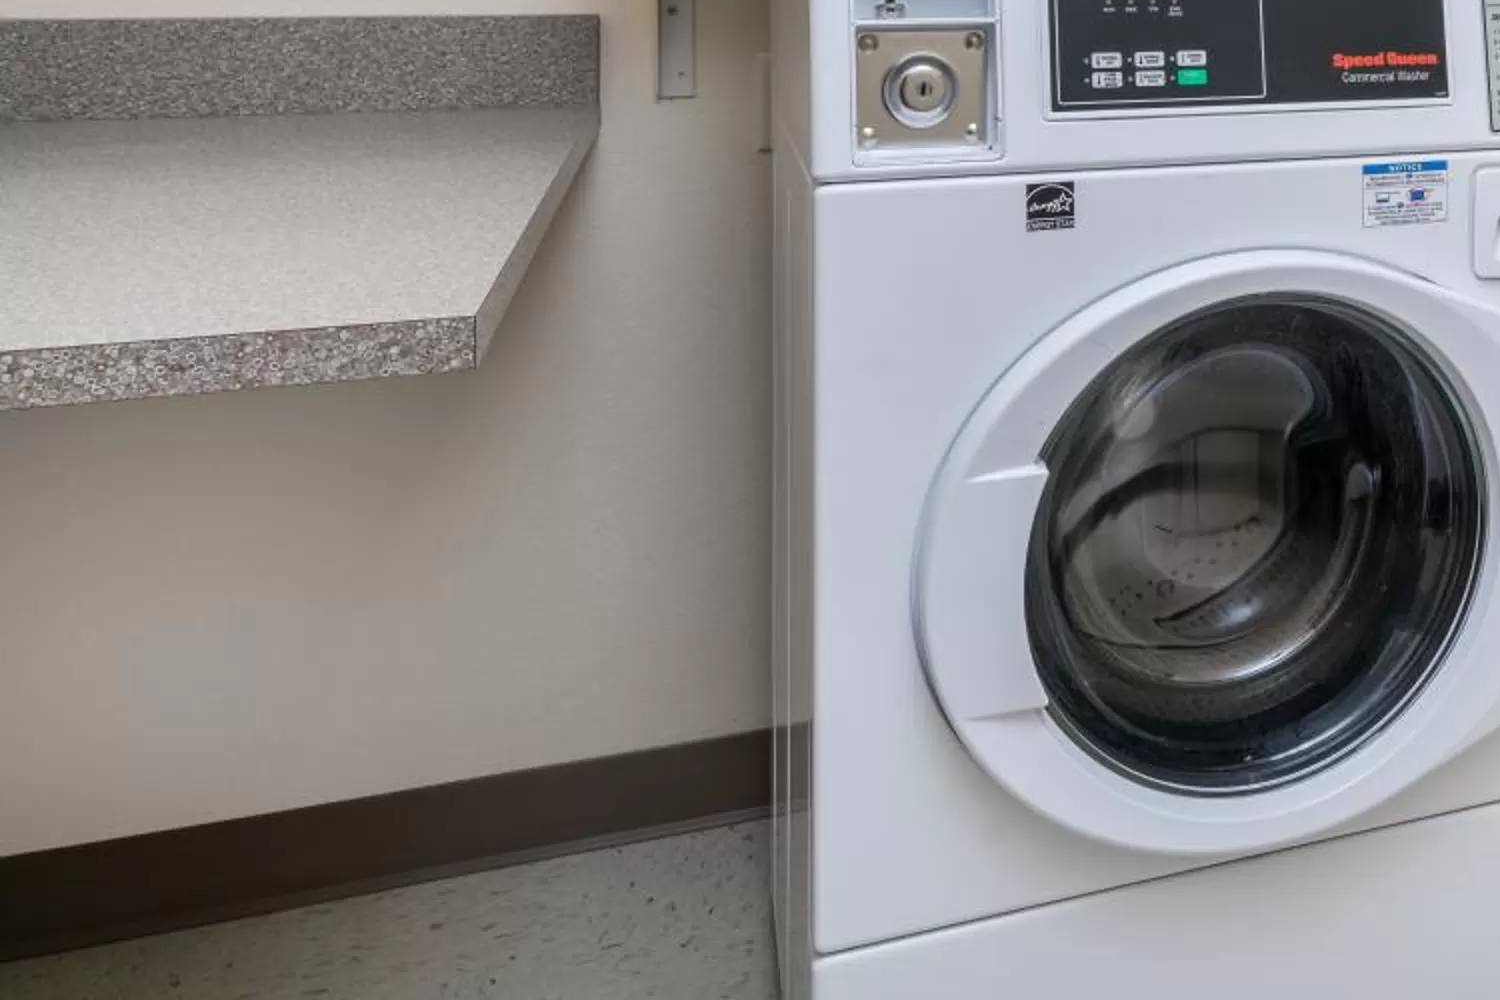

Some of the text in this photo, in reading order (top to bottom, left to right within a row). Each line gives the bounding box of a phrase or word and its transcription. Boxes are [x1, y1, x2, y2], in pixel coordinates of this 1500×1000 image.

[1332, 51, 1439, 70] Speed Queen
[1341, 70, 1430, 83] Commercial Washer
